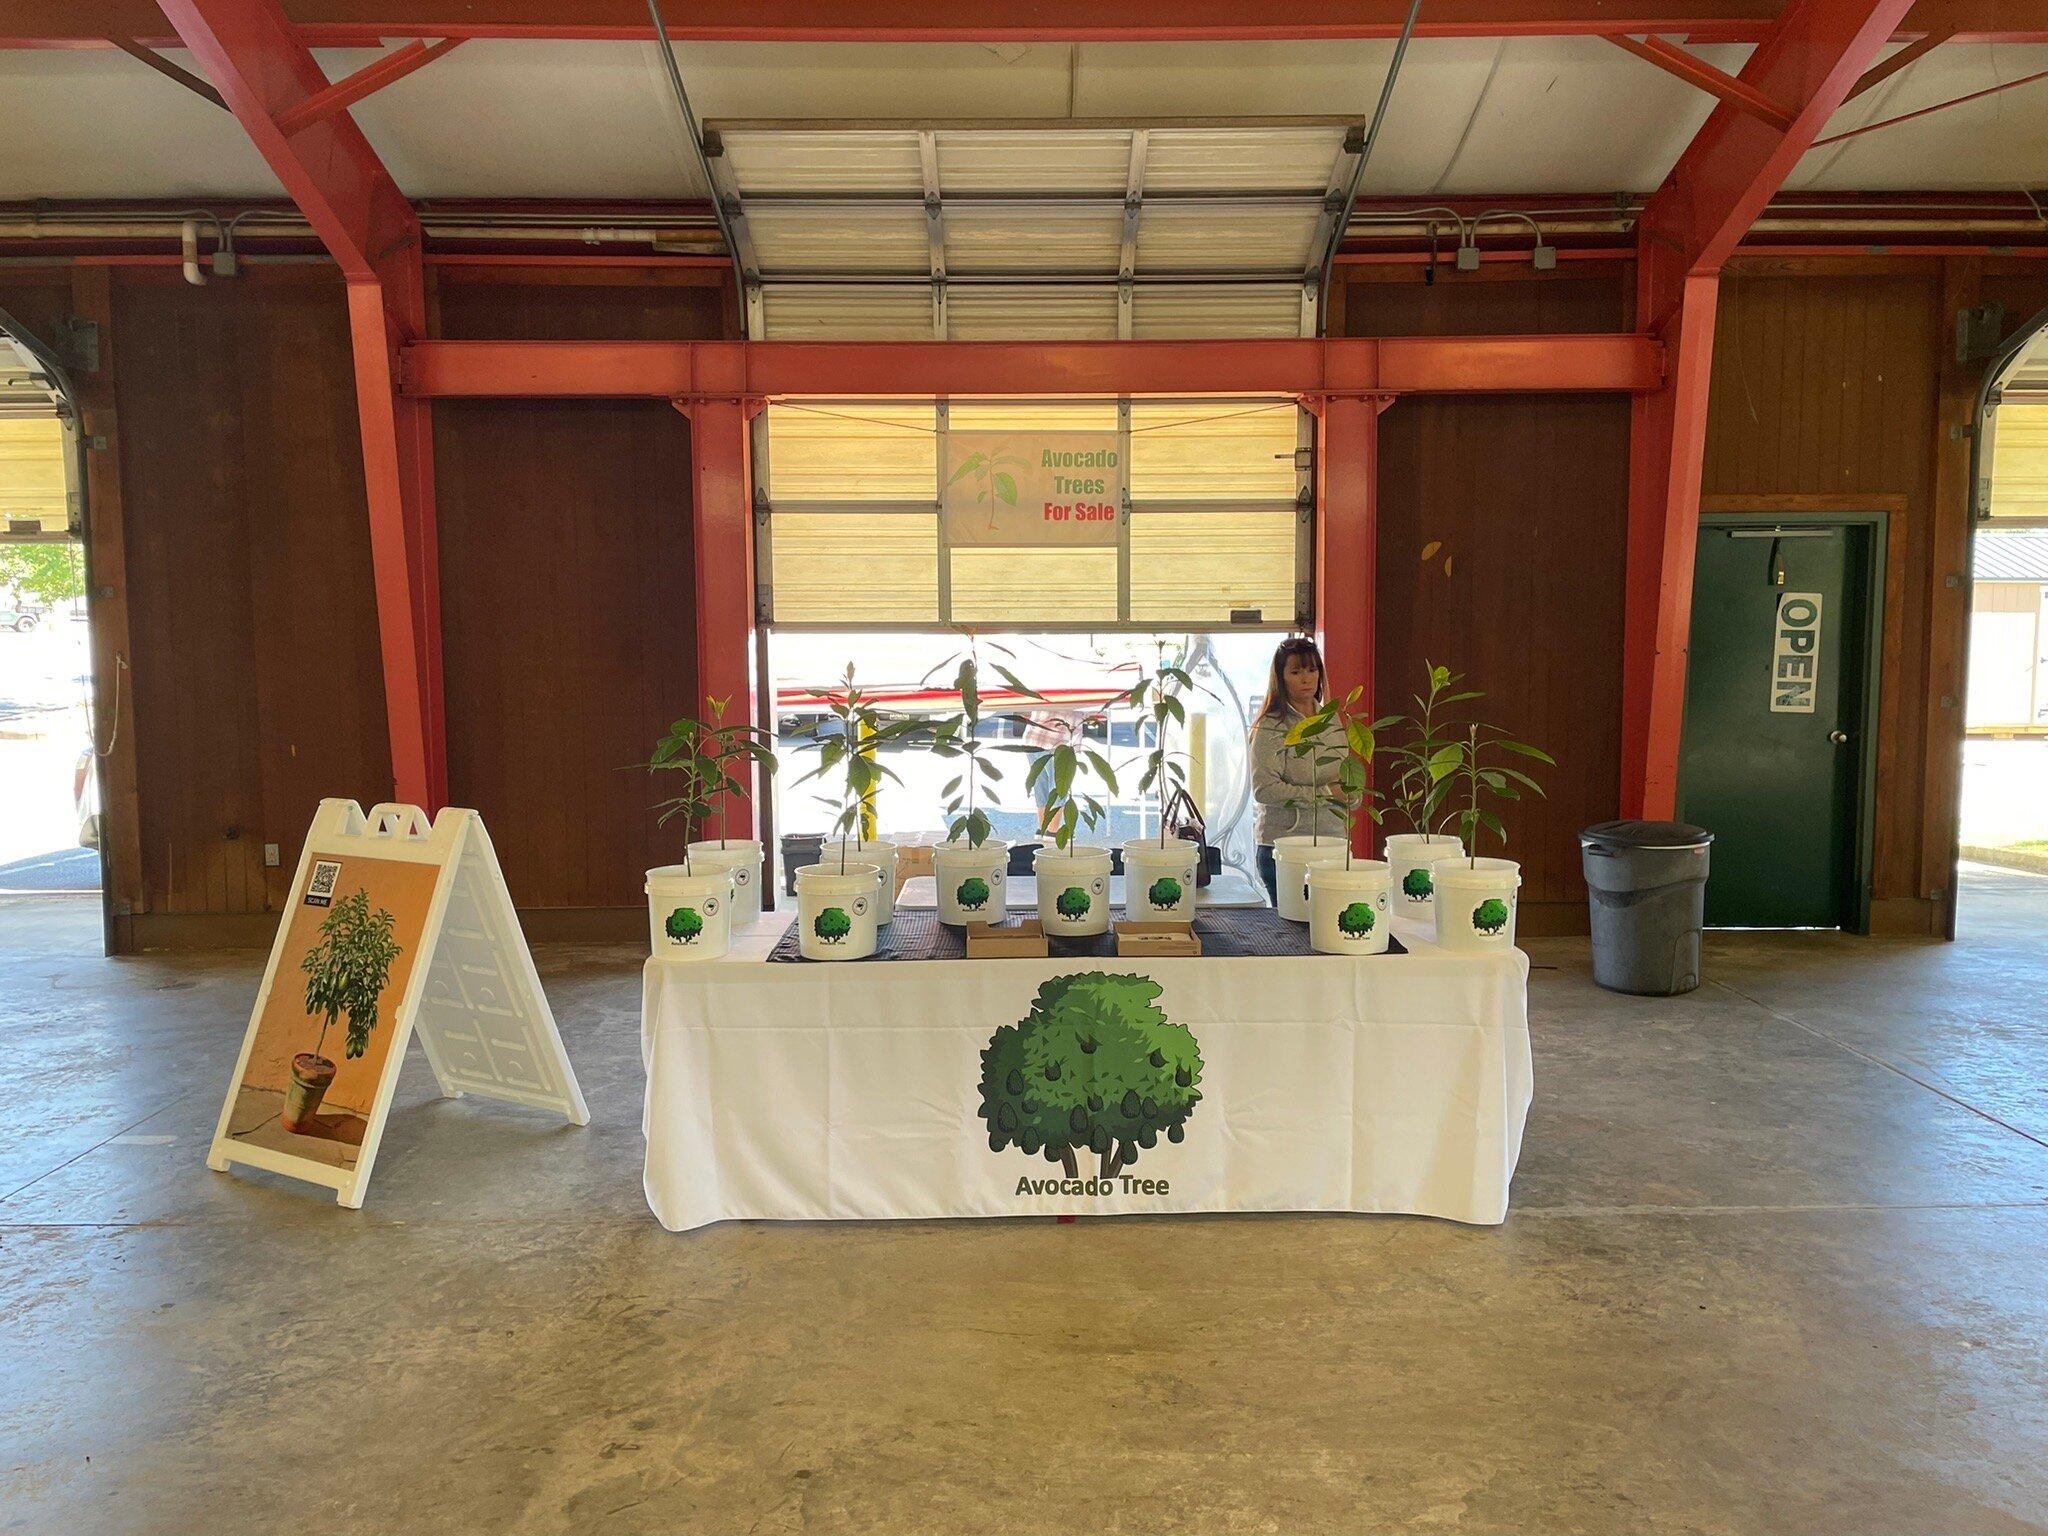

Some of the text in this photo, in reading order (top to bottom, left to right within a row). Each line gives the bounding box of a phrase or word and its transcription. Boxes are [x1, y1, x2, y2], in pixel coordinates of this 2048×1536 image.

[1041, 448, 1118, 468] Avocado
[1053, 475, 1105, 495] Trees
[1044, 502, 1115, 521] For Sale
[1775, 598, 1818, 707] OPEN
[1014, 1174, 1170, 1197] Avocado Tree
